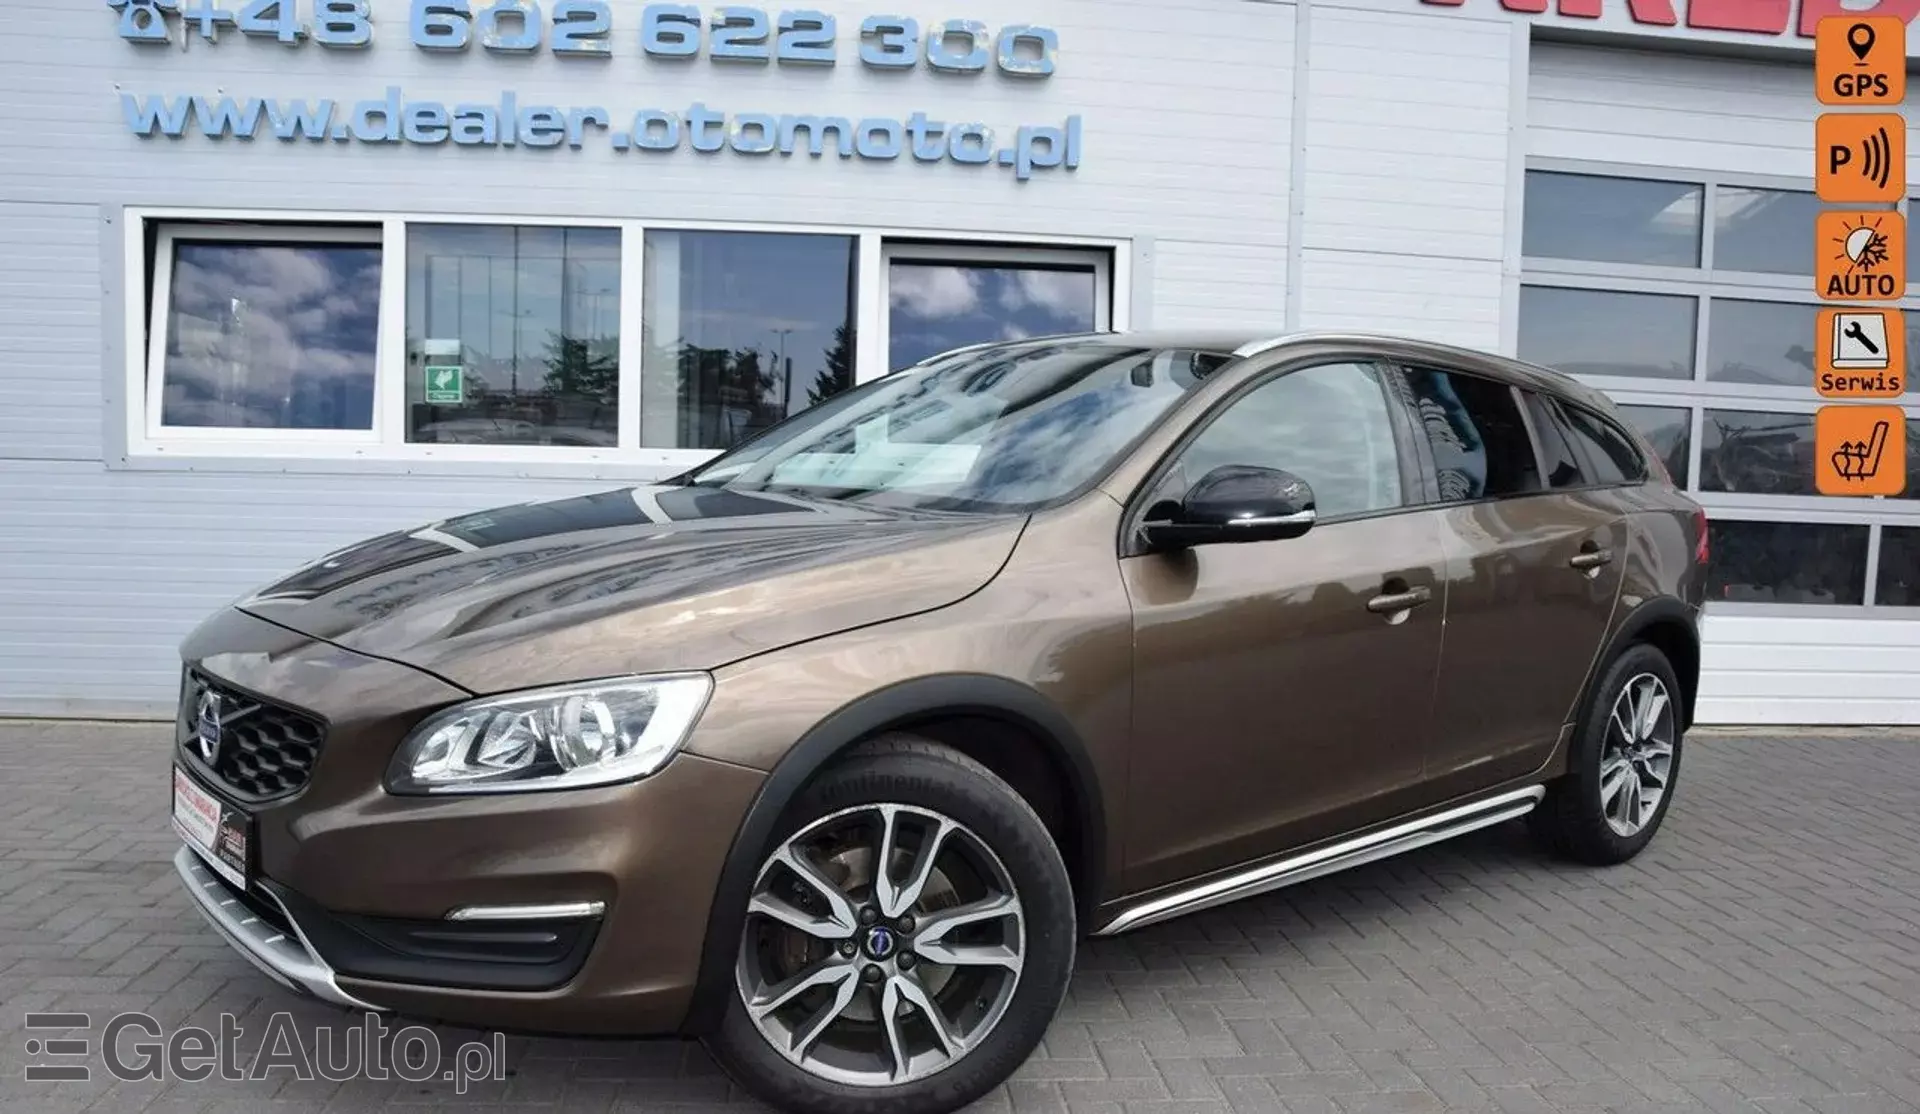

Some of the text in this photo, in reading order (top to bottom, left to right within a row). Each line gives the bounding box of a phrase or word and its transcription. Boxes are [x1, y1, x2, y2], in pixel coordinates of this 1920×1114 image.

[409, 0, 612, 57] 602
[641, 3, 837, 65] 622
[860, 14, 1059, 79] 300
[121, 86, 1082, 180] www.dealer.otomoto.pl
